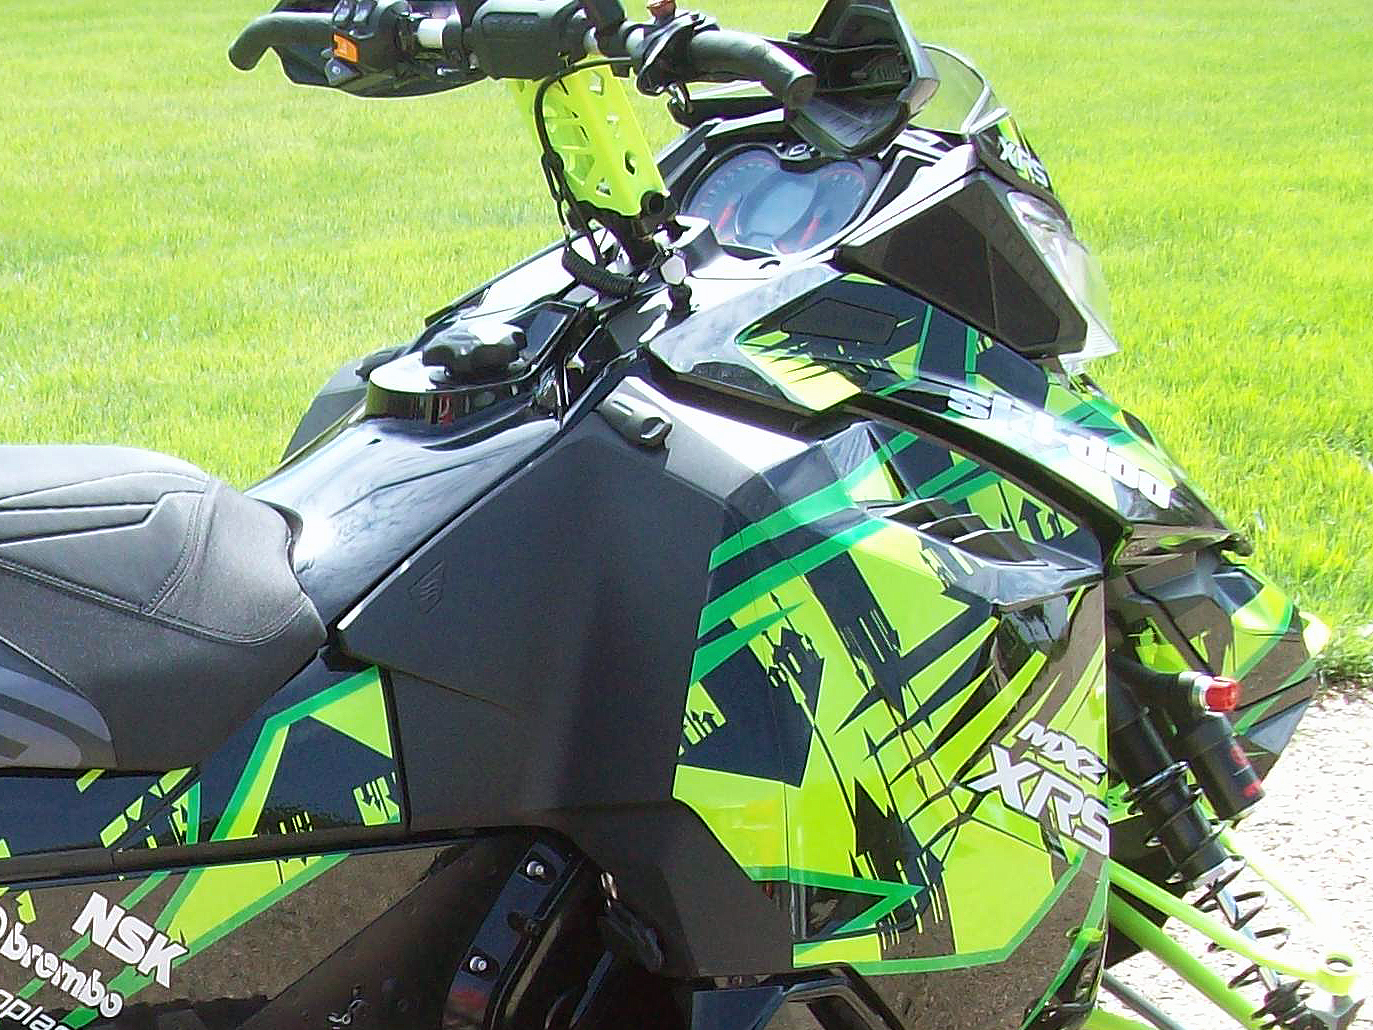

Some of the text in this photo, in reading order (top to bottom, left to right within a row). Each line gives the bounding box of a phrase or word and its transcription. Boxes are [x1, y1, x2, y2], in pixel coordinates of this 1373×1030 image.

[967, 744, 1109, 856] XRS
[0, 922, 123, 1019] brembo
[72, 891, 188, 989] NSK
